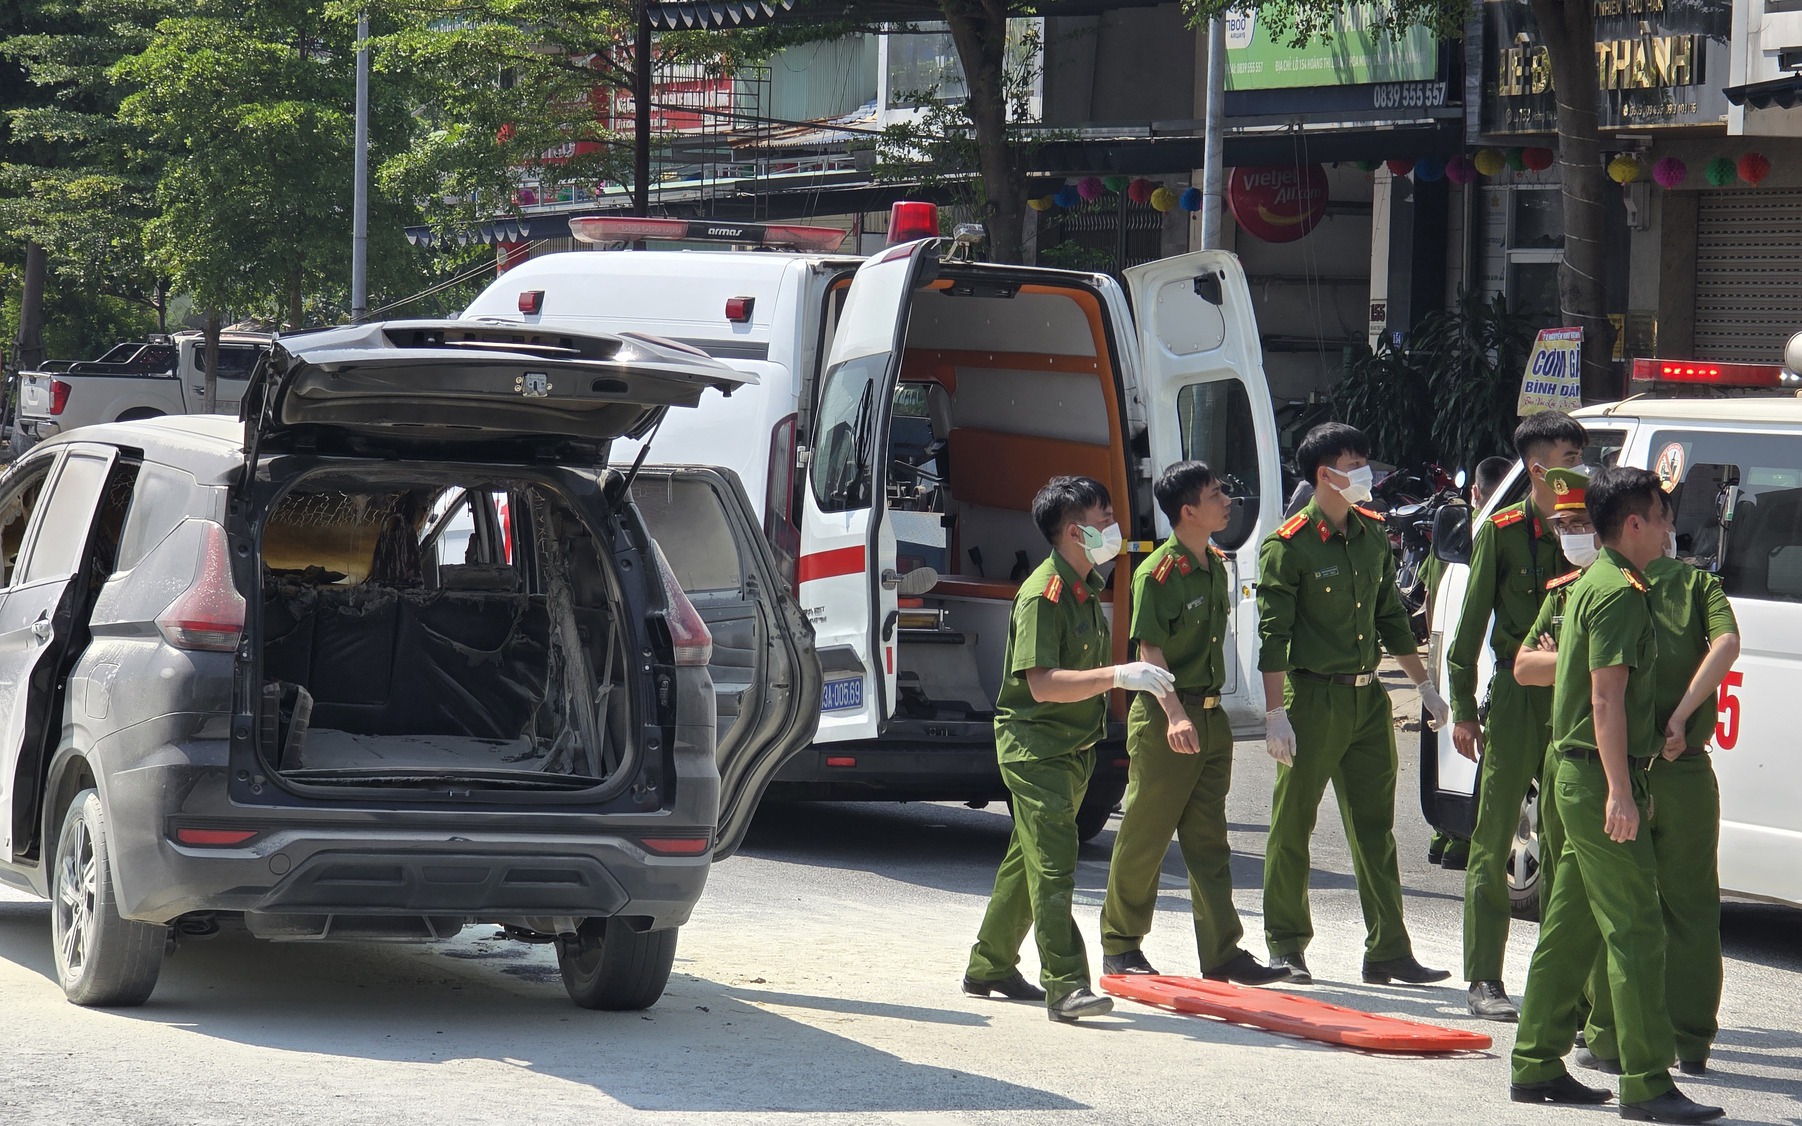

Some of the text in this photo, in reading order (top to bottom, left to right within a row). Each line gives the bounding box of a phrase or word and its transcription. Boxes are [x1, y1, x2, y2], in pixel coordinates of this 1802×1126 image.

[1595, 20, 1692, 91] THÀNH
[1374, 82, 1446, 108] 0839 555 557
[1371, 303, 1386, 322] 155
[1532, 348, 1567, 379] CƠM
[1524, 379, 1558, 395] BÌNH
[822, 681, 861, 710] 3A-005.69
